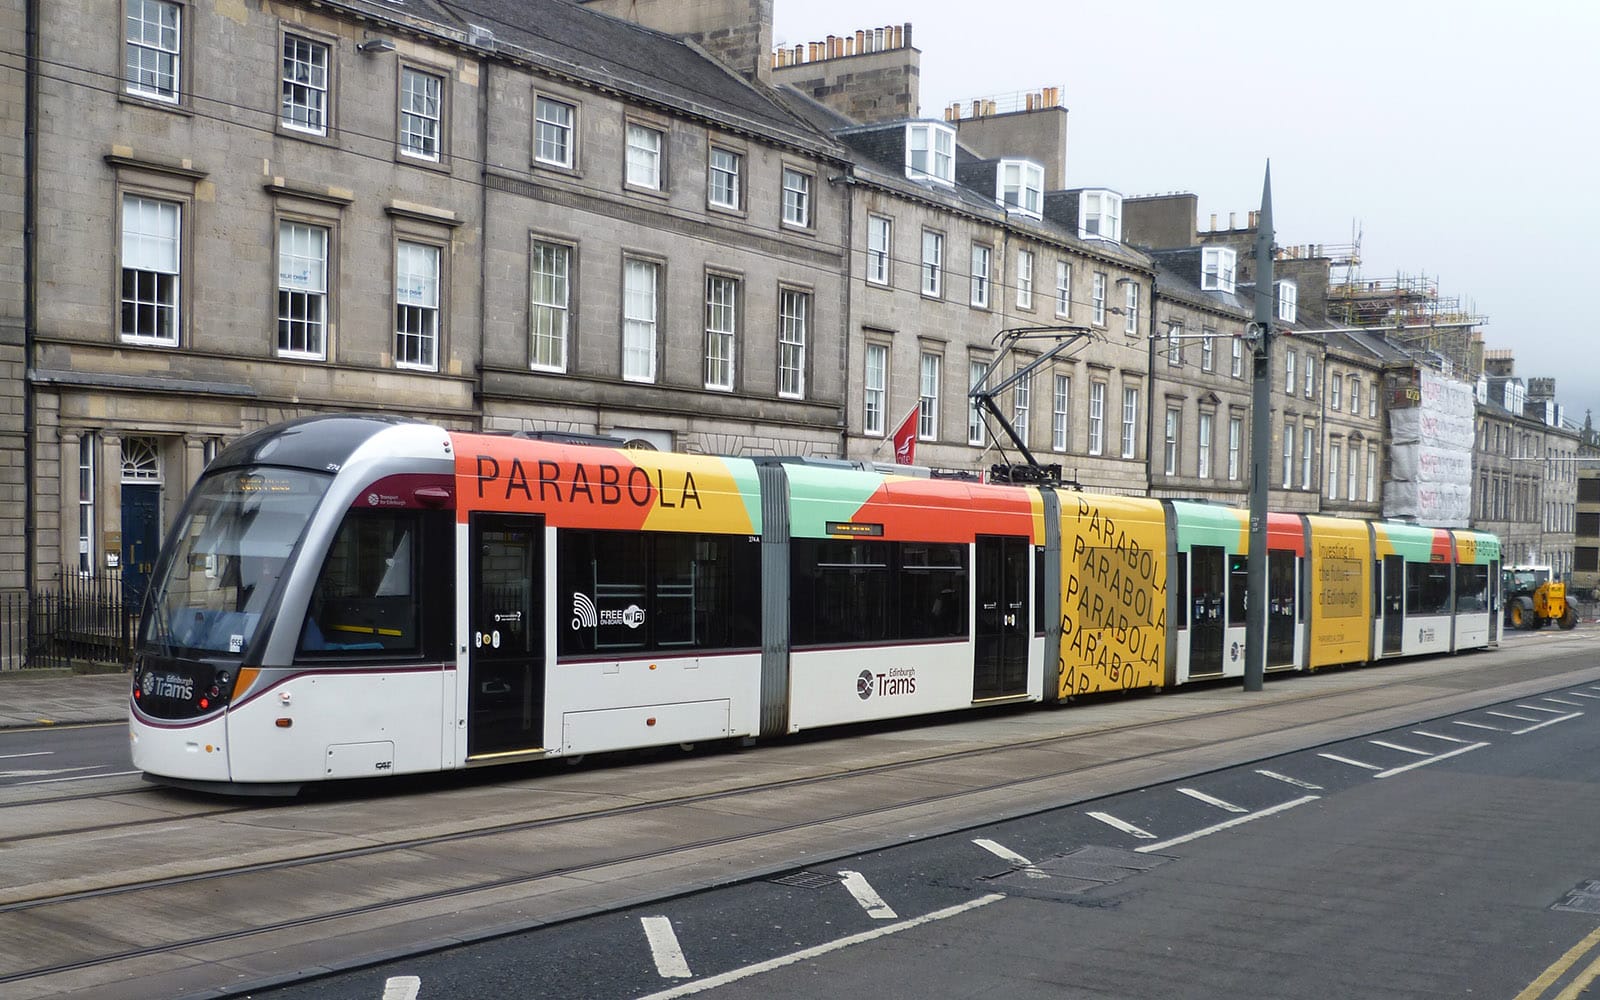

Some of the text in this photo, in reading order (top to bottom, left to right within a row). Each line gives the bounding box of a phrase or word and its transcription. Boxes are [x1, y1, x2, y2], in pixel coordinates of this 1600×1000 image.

[325, 463, 341, 472] 274
[476, 454, 702, 510] PARABOLA
[1073, 534, 1165, 637] PARABOLA
[600, 610, 623, 619] FREE
[1066, 574, 1159, 673] PARABOLA
[231, 639, 242, 647] 955
[1060, 614, 1153, 691] PARABO
[166, 674, 195, 687] Edinburgh
[889, 667, 916, 678] Edinburgh
[155, 677, 194, 701] Trams
[876, 673, 917, 697] Trams
